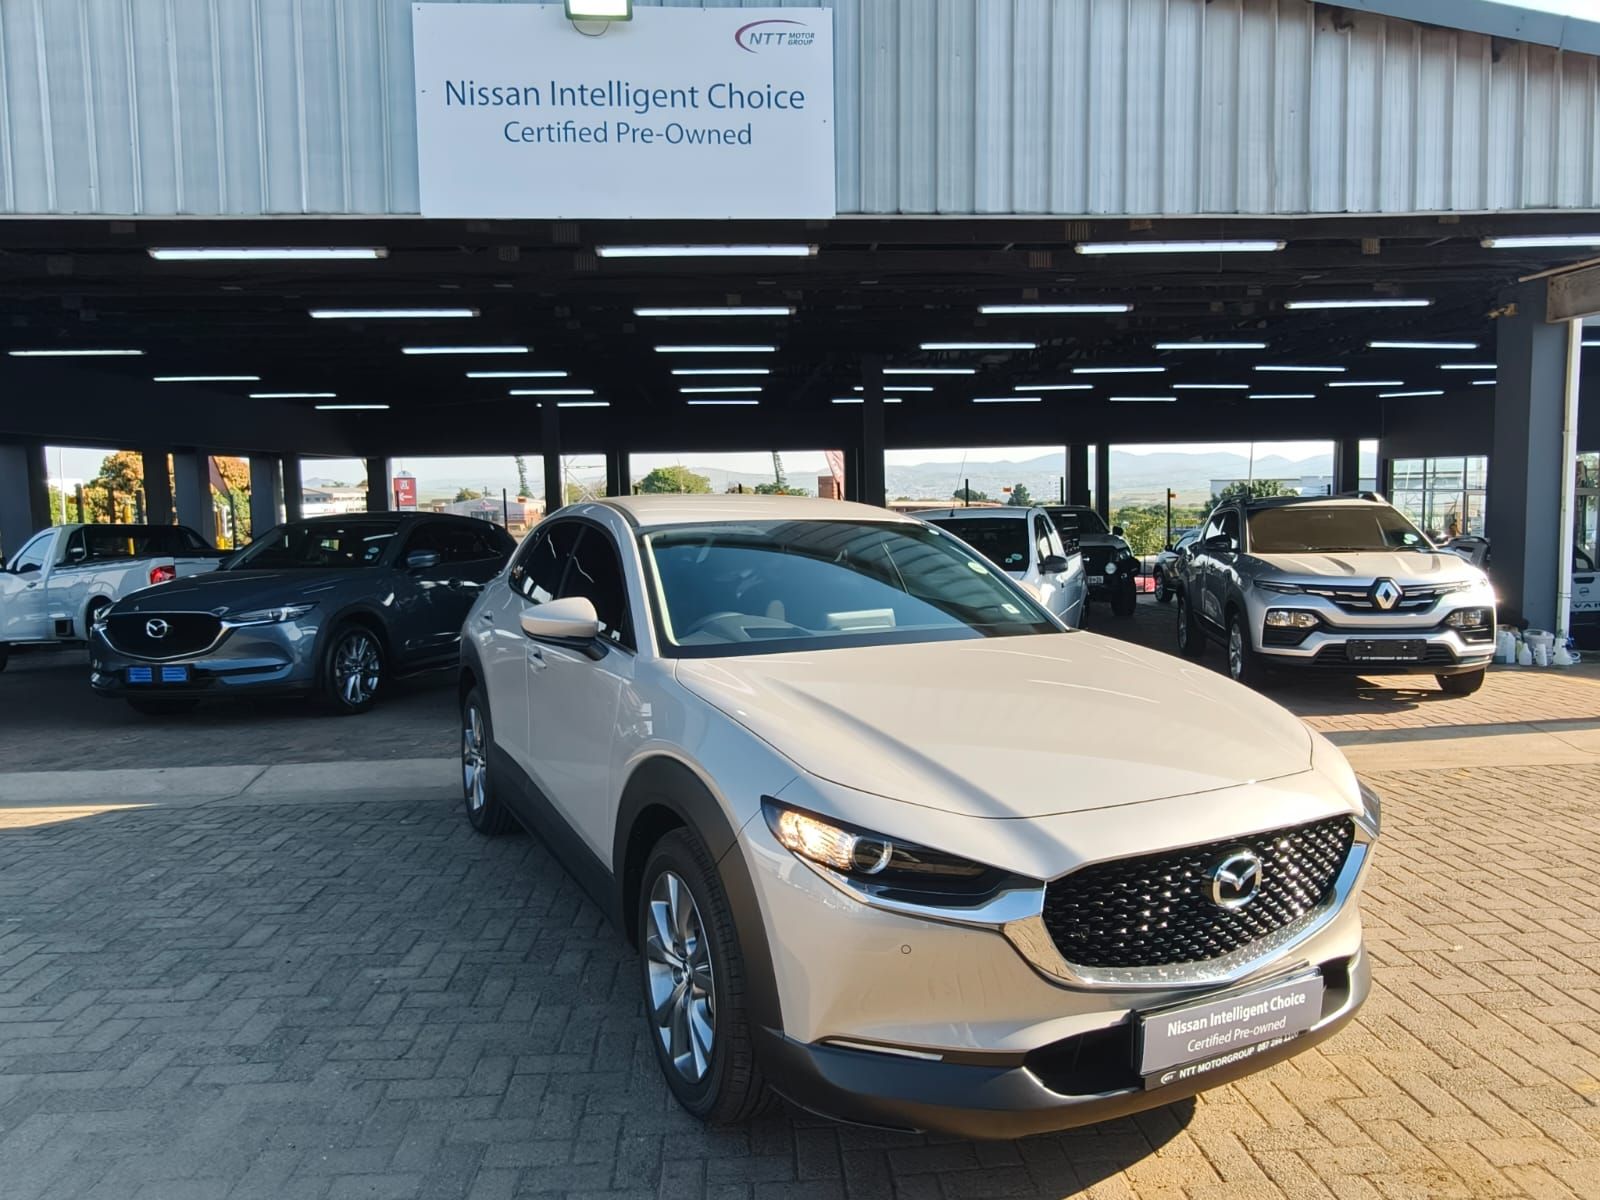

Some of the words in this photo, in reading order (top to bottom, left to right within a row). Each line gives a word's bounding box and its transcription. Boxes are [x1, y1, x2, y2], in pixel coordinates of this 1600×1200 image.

[749, 32, 787, 46] NTT
[445, 80, 540, 106] Nissan
[551, 80, 699, 114] Intelligent
[708, 83, 805, 110] Choice
[503, 120, 608, 144] Certified
[616, 122, 752, 145] Pre-Owned
[1167, 1017, 1208, 1037] Nissan
[1210, 1000, 1269, 1027] Intelligent
[1270, 993, 1306, 1011] Choice
[1187, 1030, 1232, 1052] Certified
[1233, 1016, 1287, 1040] Pre-owned
[1179, 1065, 1197, 1079] NTT
[1197, 1046, 1255, 1073] MOTORGROUP
